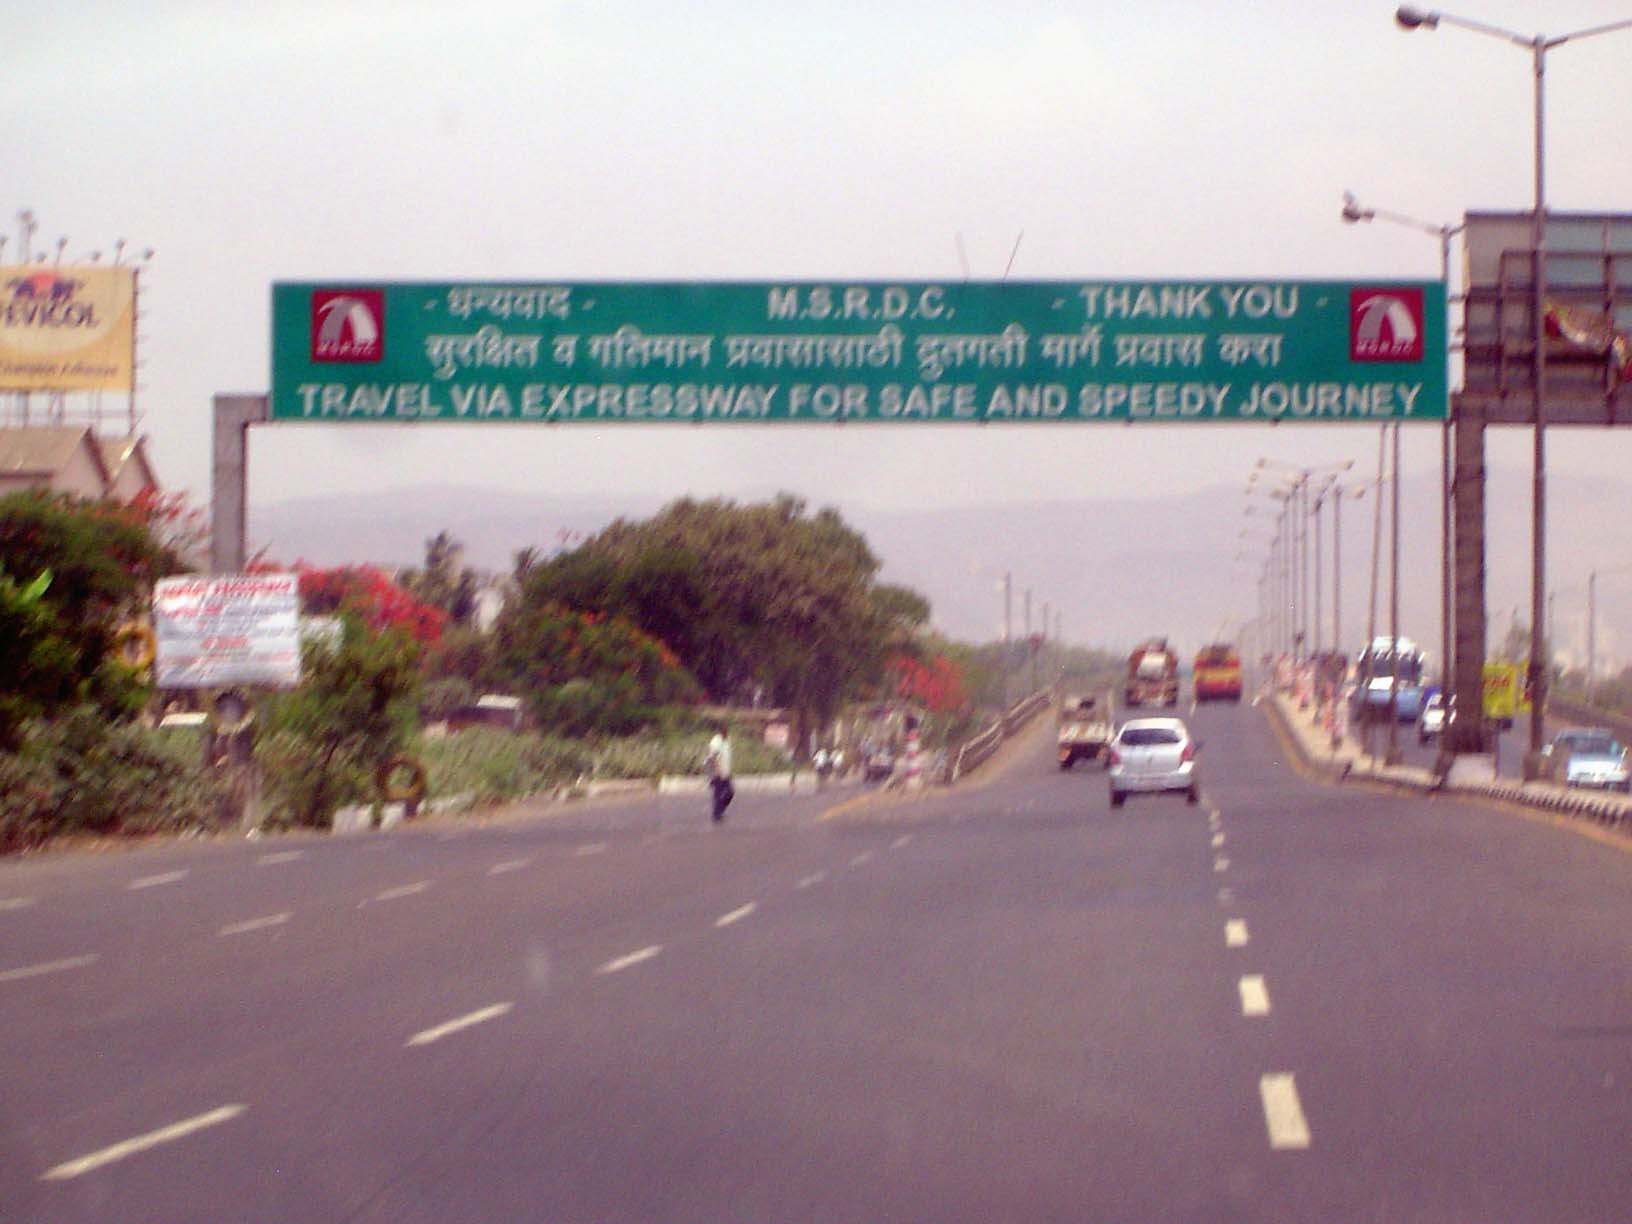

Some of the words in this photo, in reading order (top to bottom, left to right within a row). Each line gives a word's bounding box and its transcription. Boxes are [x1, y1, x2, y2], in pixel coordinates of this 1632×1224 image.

[447, 287, 572, 319] धन्यवाद
[766, 286, 956, 320] M.S.R.D.C.
[1078, 285, 1212, 319] THANK
[1220, 285, 1300, 319] YOU
[551, 334, 580, 368] व
[1112, 332, 1206, 368] प्रवास
[1217, 332, 1284, 368] करा
[298, 384, 442, 418] TRAVEL
[449, 384, 513, 418] VIA
[519, 384, 779, 418] EXPRESSWAY
[787, 384, 870, 418] FOR
[877, 384, 978, 418] SAFE
[985, 384, 1069, 418] AND
[1077, 383, 1232, 418] SPEEDY
[1238, 383, 1422, 417] JOURNEY
